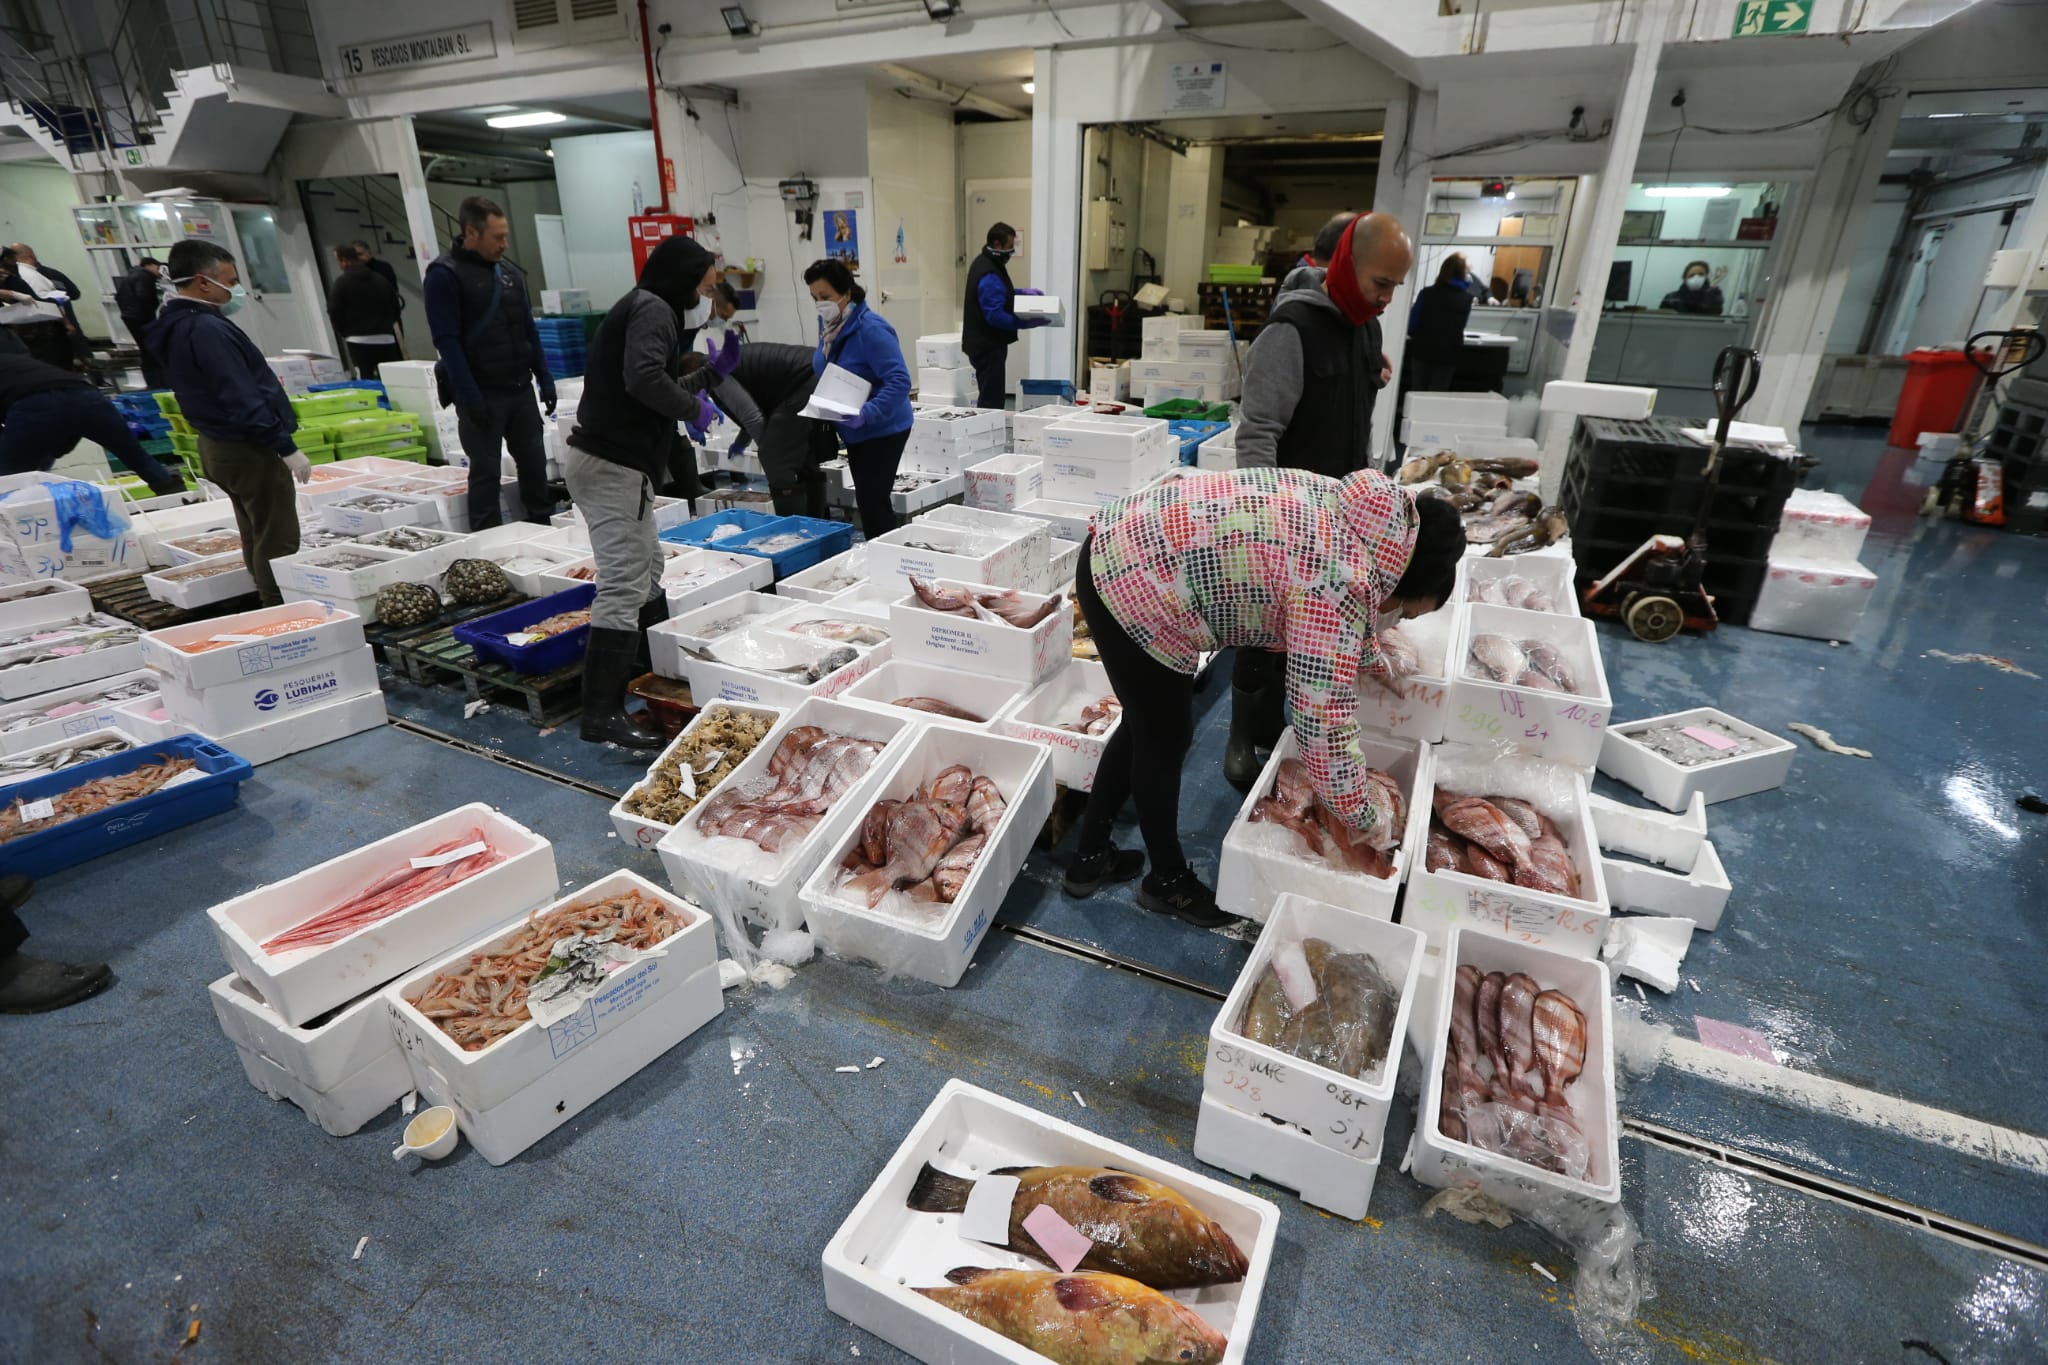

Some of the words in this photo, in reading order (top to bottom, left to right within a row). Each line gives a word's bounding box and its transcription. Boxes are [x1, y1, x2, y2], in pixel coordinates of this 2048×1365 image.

[344, 48, 363, 73] 15
[371, 43, 410, 67] PESCADOS
[931, 626, 966, 638] DIPROMER
[282, 670, 336, 690] PESQUERIAS
[285, 678, 338, 700] LUBIMAR
[594, 983, 625, 1006] Pescados
[624, 975, 637, 987] Mar
[637, 968, 648, 980] del
[647, 961, 658, 974] Sol
